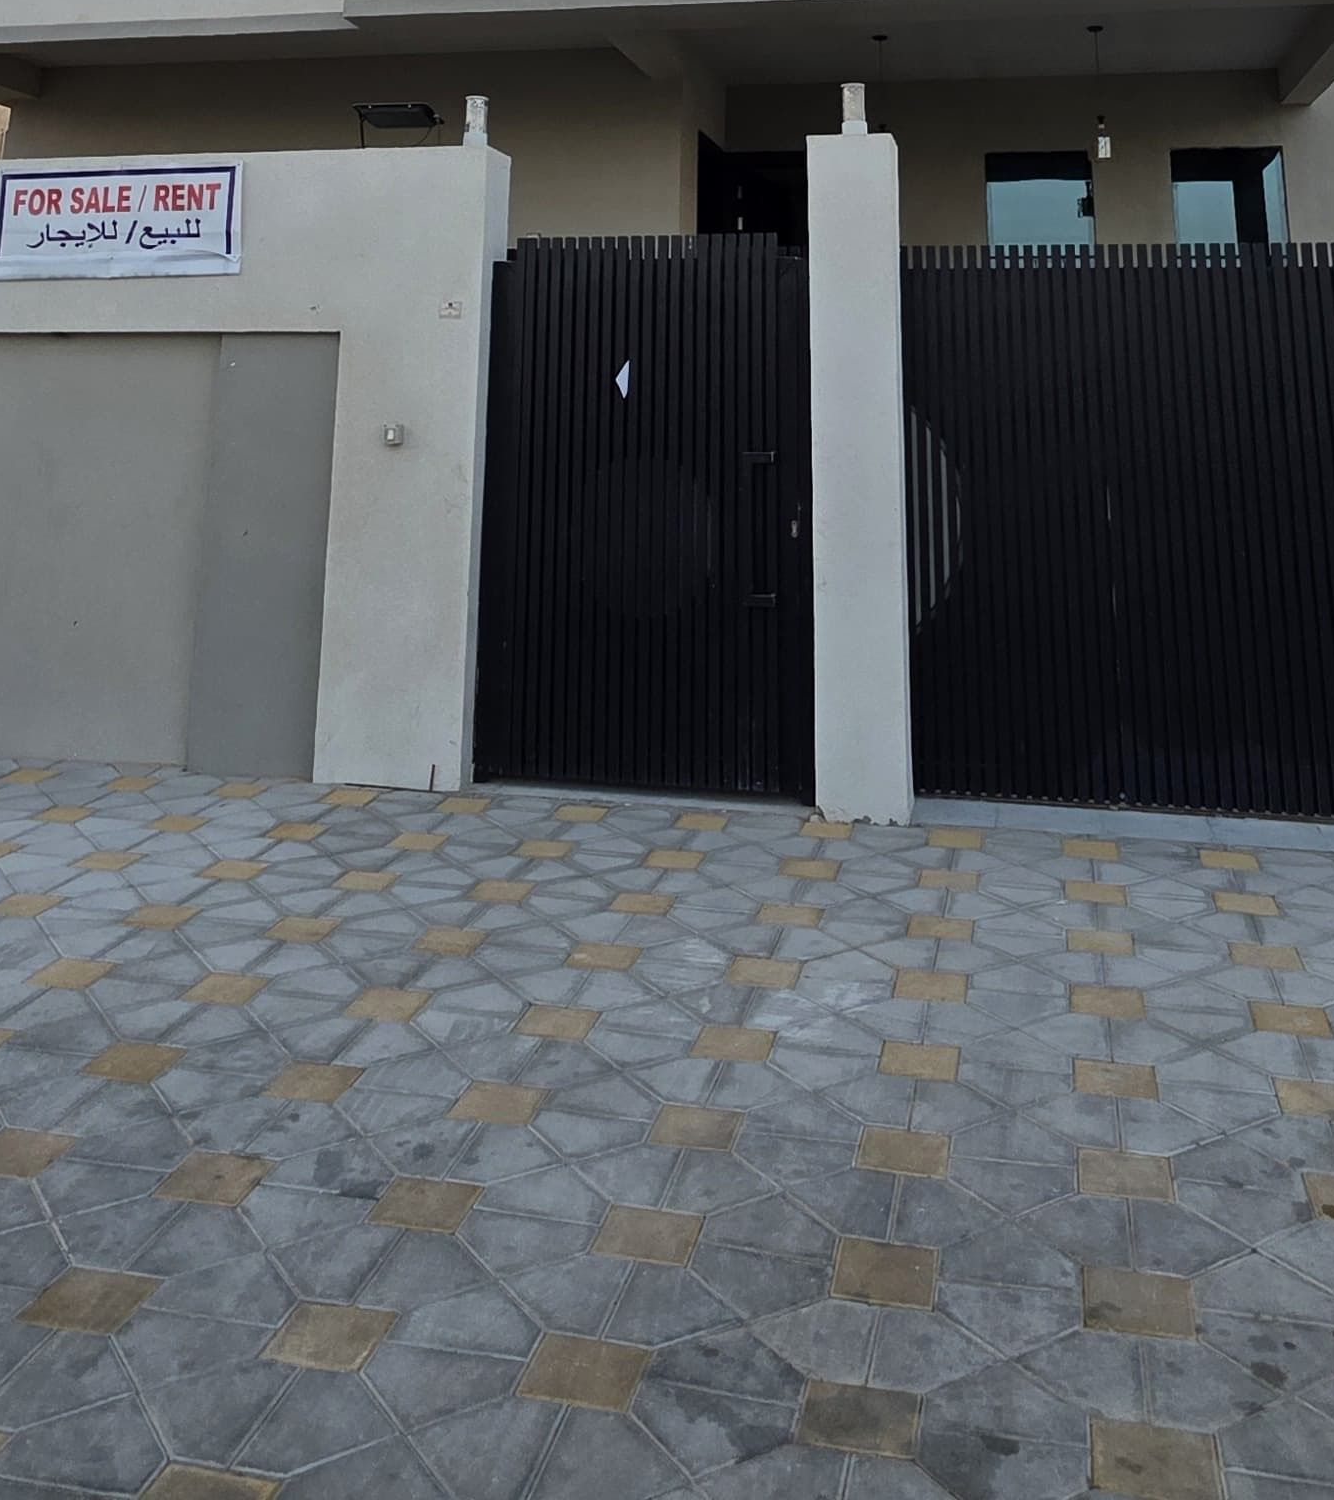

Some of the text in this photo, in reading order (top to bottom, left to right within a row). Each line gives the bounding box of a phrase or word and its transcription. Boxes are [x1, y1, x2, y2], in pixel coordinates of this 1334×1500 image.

[13, 187, 63, 215] FOR
[70, 185, 132, 213] SALE
[153, 182, 221, 212] RENT
